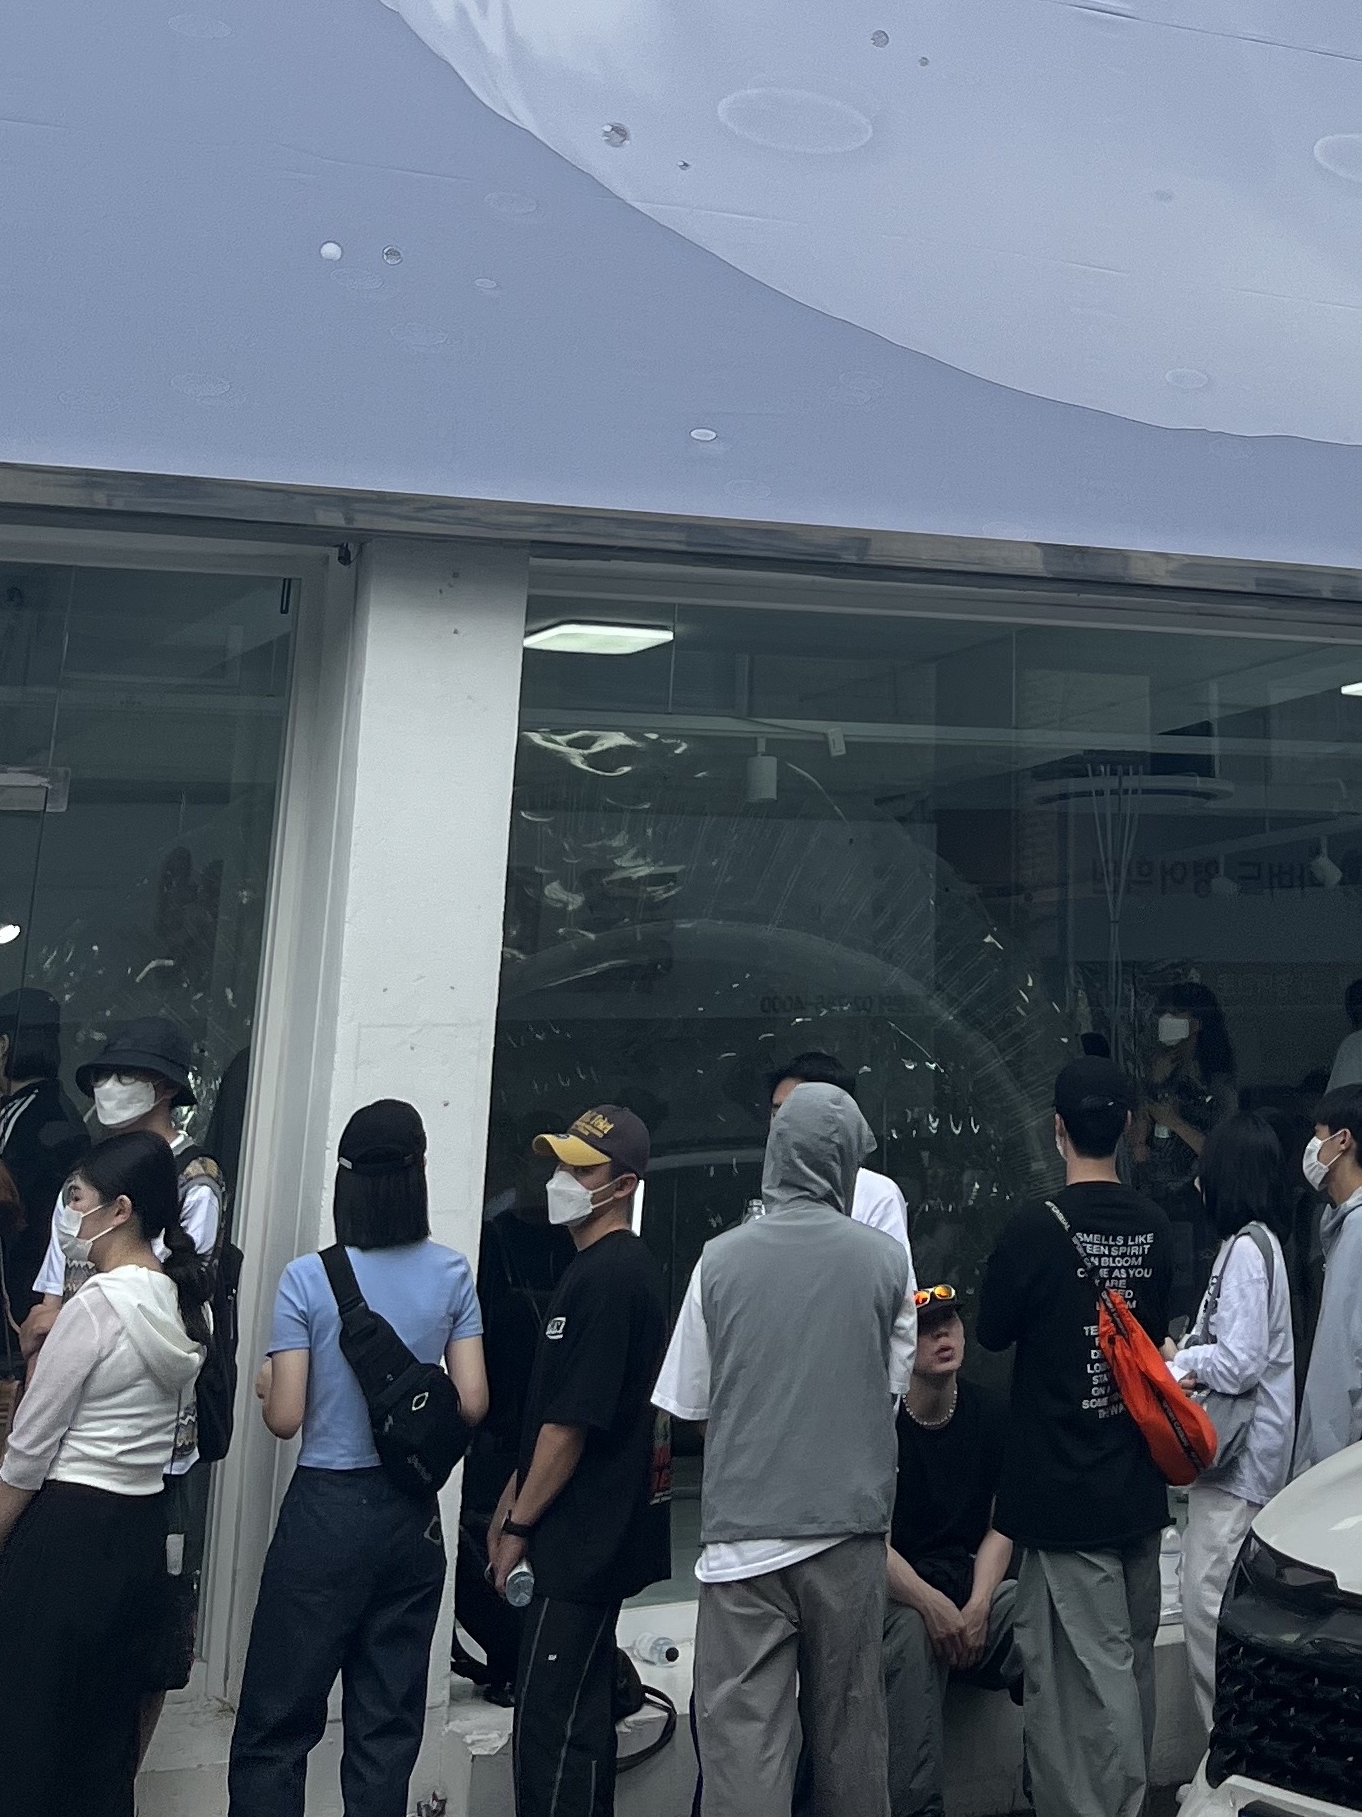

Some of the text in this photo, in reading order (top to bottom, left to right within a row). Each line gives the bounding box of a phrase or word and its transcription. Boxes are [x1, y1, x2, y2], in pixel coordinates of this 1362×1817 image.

[1075, 1232, 1155, 1246] SMELLS LIKE
[1110, 1244, 1151, 1256] SPIRIT
[1101, 1256, 1143, 1267] BLOOM
[1111, 1268, 1127, 1278] AS
[1128, 1268, 1153, 1278] YOU
